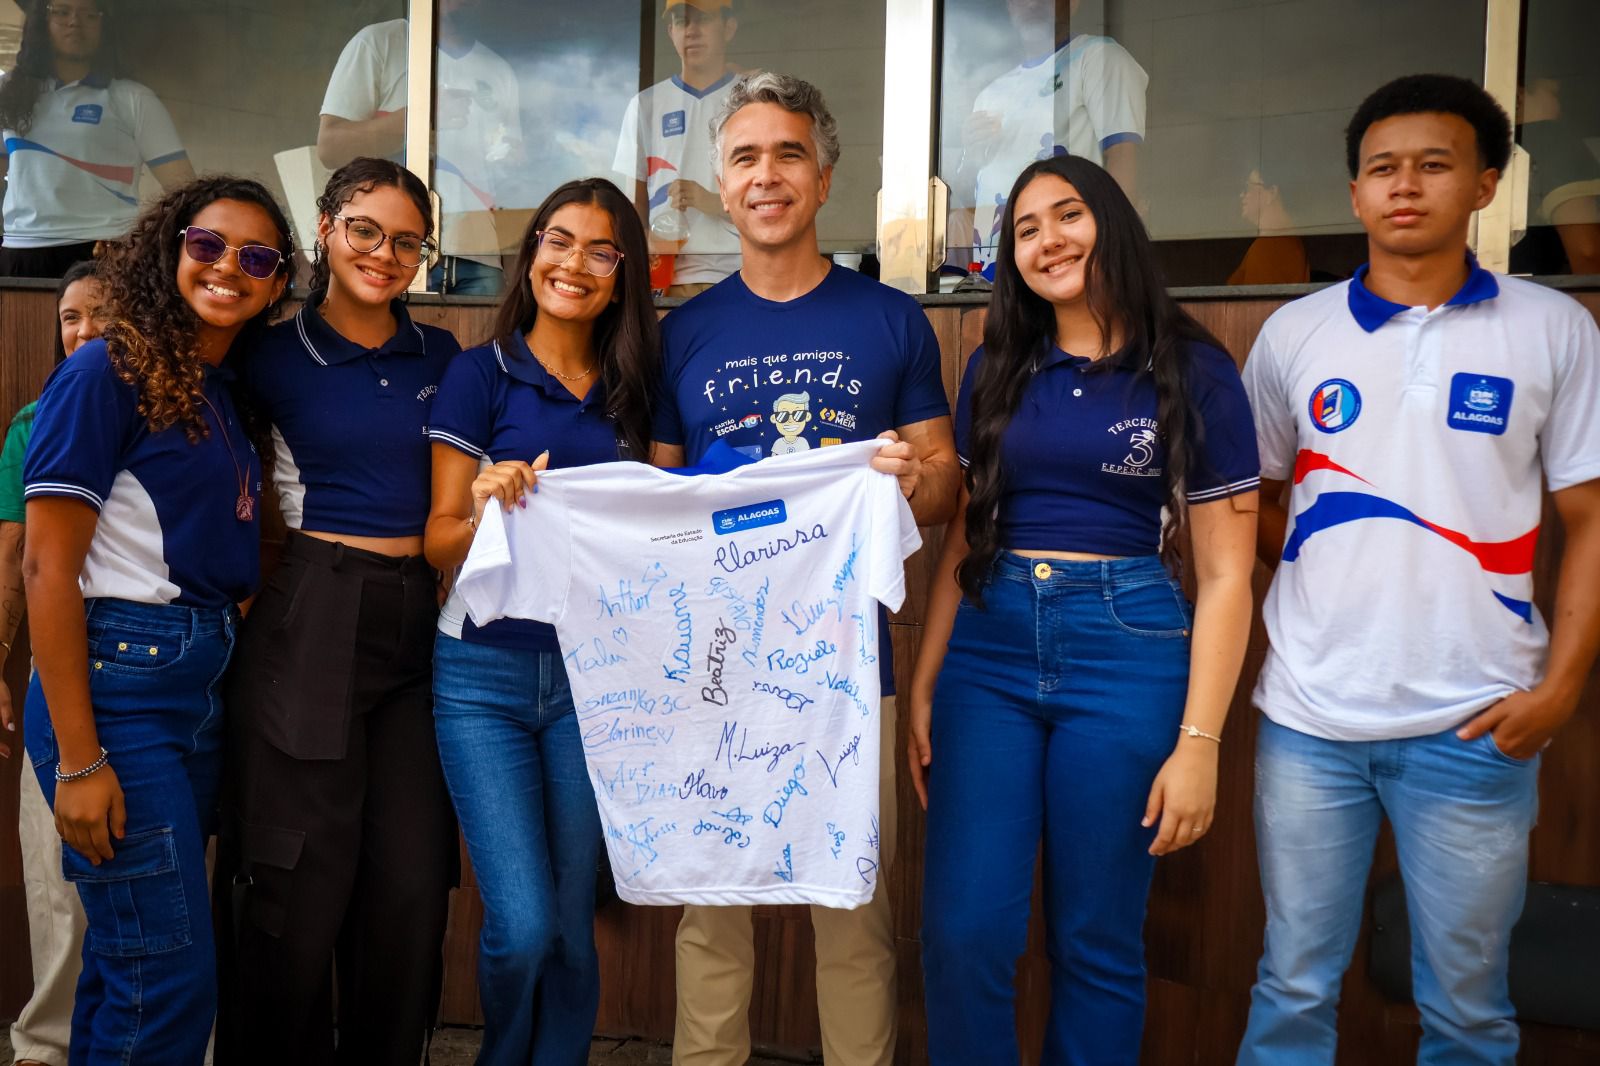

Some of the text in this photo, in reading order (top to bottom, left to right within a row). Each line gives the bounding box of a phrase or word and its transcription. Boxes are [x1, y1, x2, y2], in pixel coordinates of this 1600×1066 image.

[725, 349, 843, 369] mais que amigos
[834, 415, 856, 430] MEIA
[1107, 417, 1159, 435] TERCEIR
[1453, 411, 1504, 426] ALAGOAS
[716, 421, 744, 437] ESCOLA
[737, 507, 780, 522] ALAGOAS
[714, 524, 829, 573] Clarissa
[701, 617, 737, 706] Beatriz
[763, 755, 808, 828] Diego
